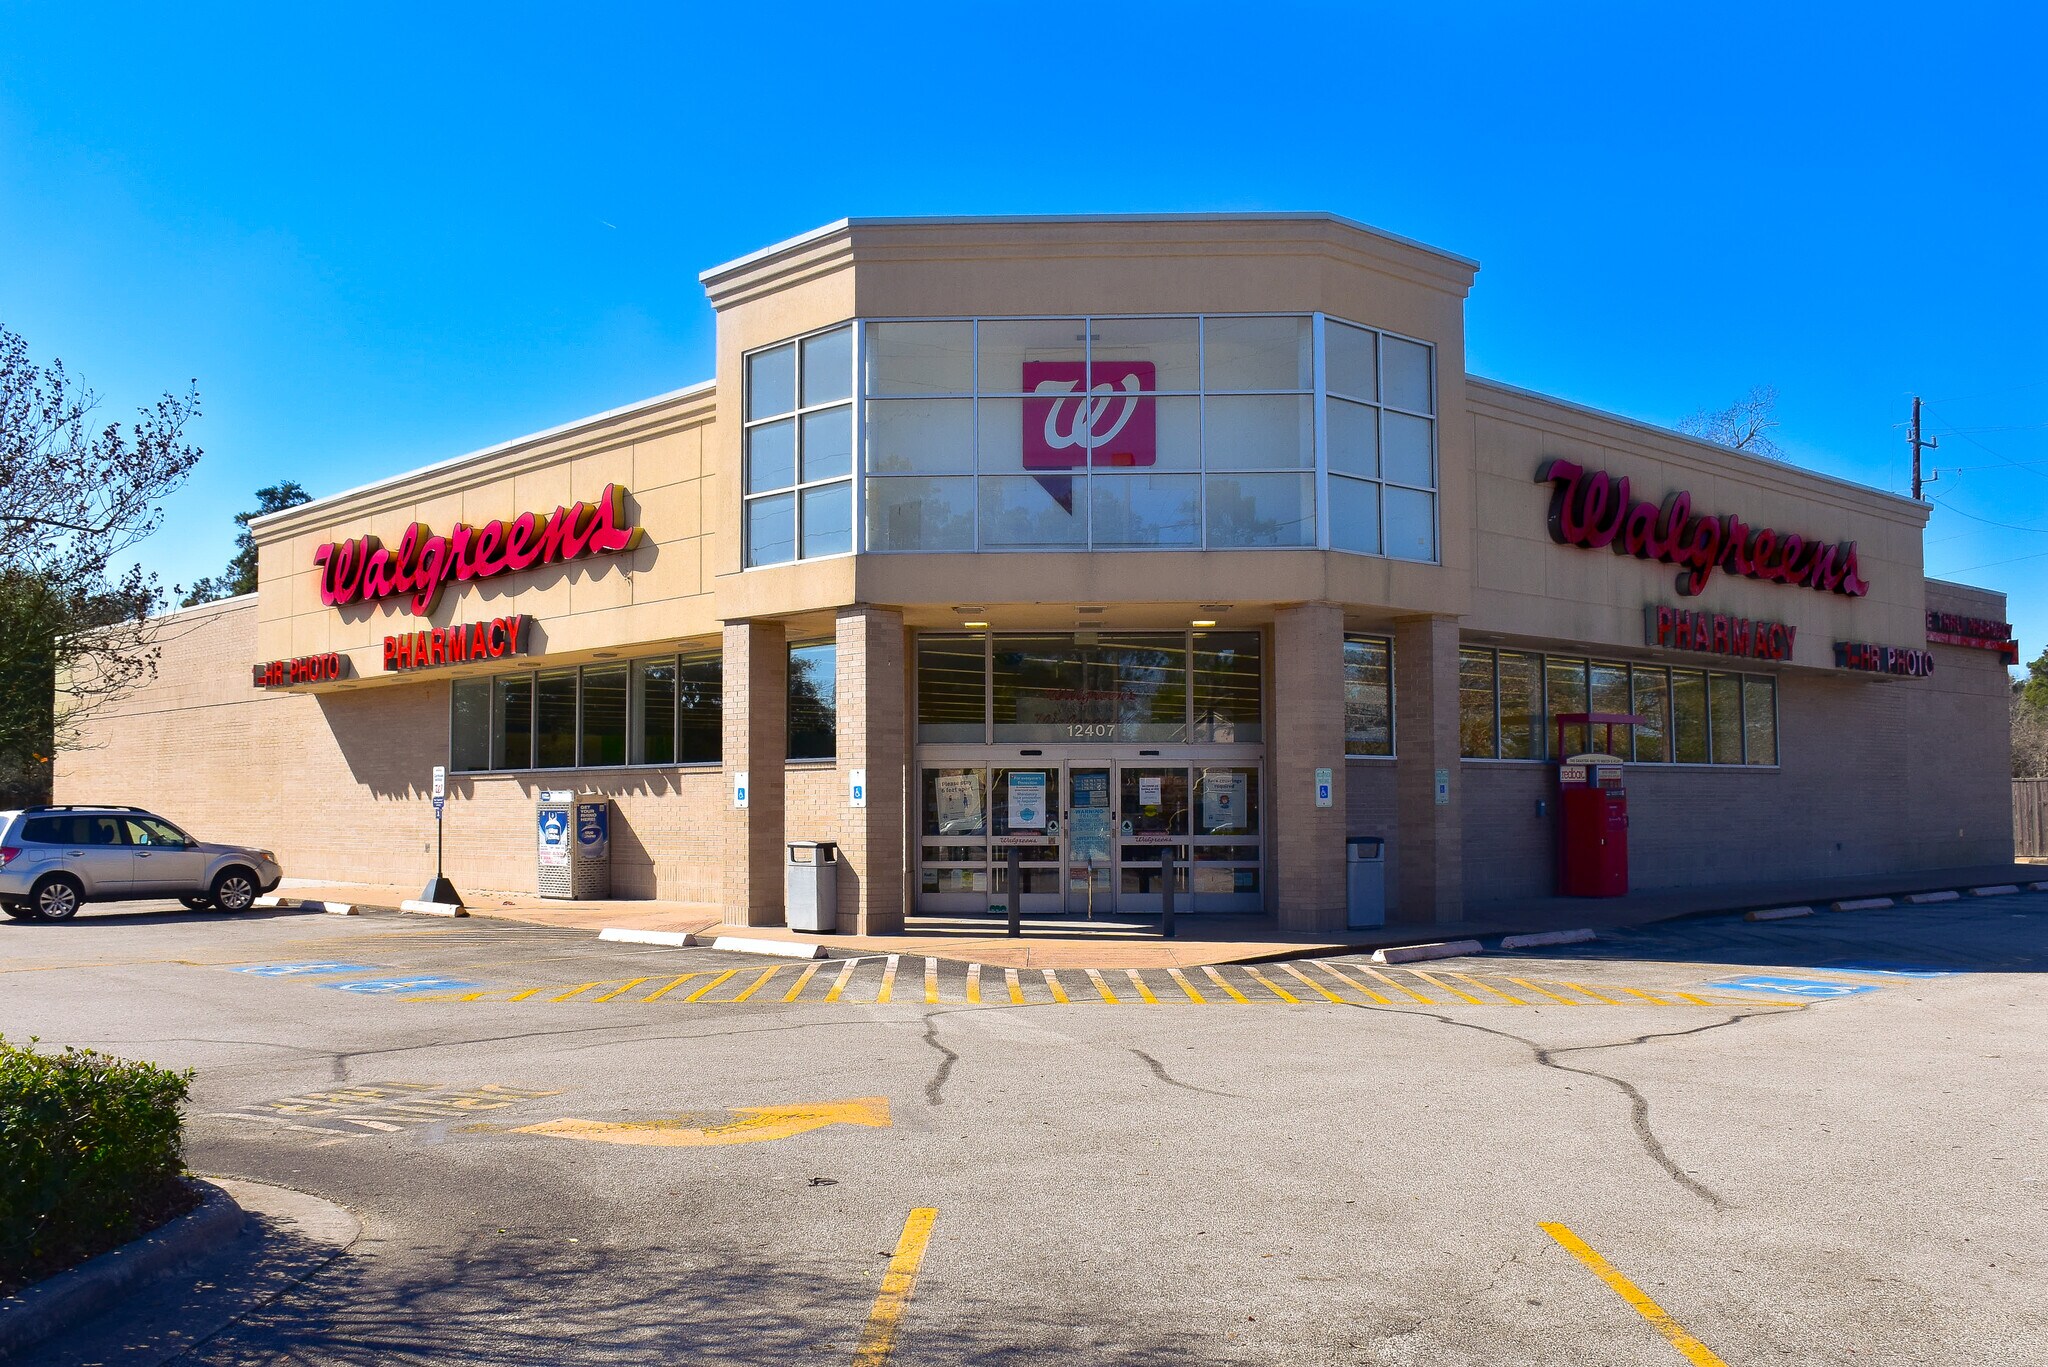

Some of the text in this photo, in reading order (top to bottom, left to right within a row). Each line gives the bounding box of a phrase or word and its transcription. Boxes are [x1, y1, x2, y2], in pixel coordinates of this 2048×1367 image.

[1545, 459, 1869, 597] Walgreens
[314, 483, 637, 616] Walgreens
[384, 615, 524, 671] PHARMACY
[1656, 605, 1797, 661] PHARMACY
[290, 652, 339, 683] PHOTO
[1888, 646, 1934, 676] PHOTO
[1066, 725, 1115, 737] 12407
[999, 836, 1038, 845] Walgreens
[1135, 836, 1173, 844] Walgreens
